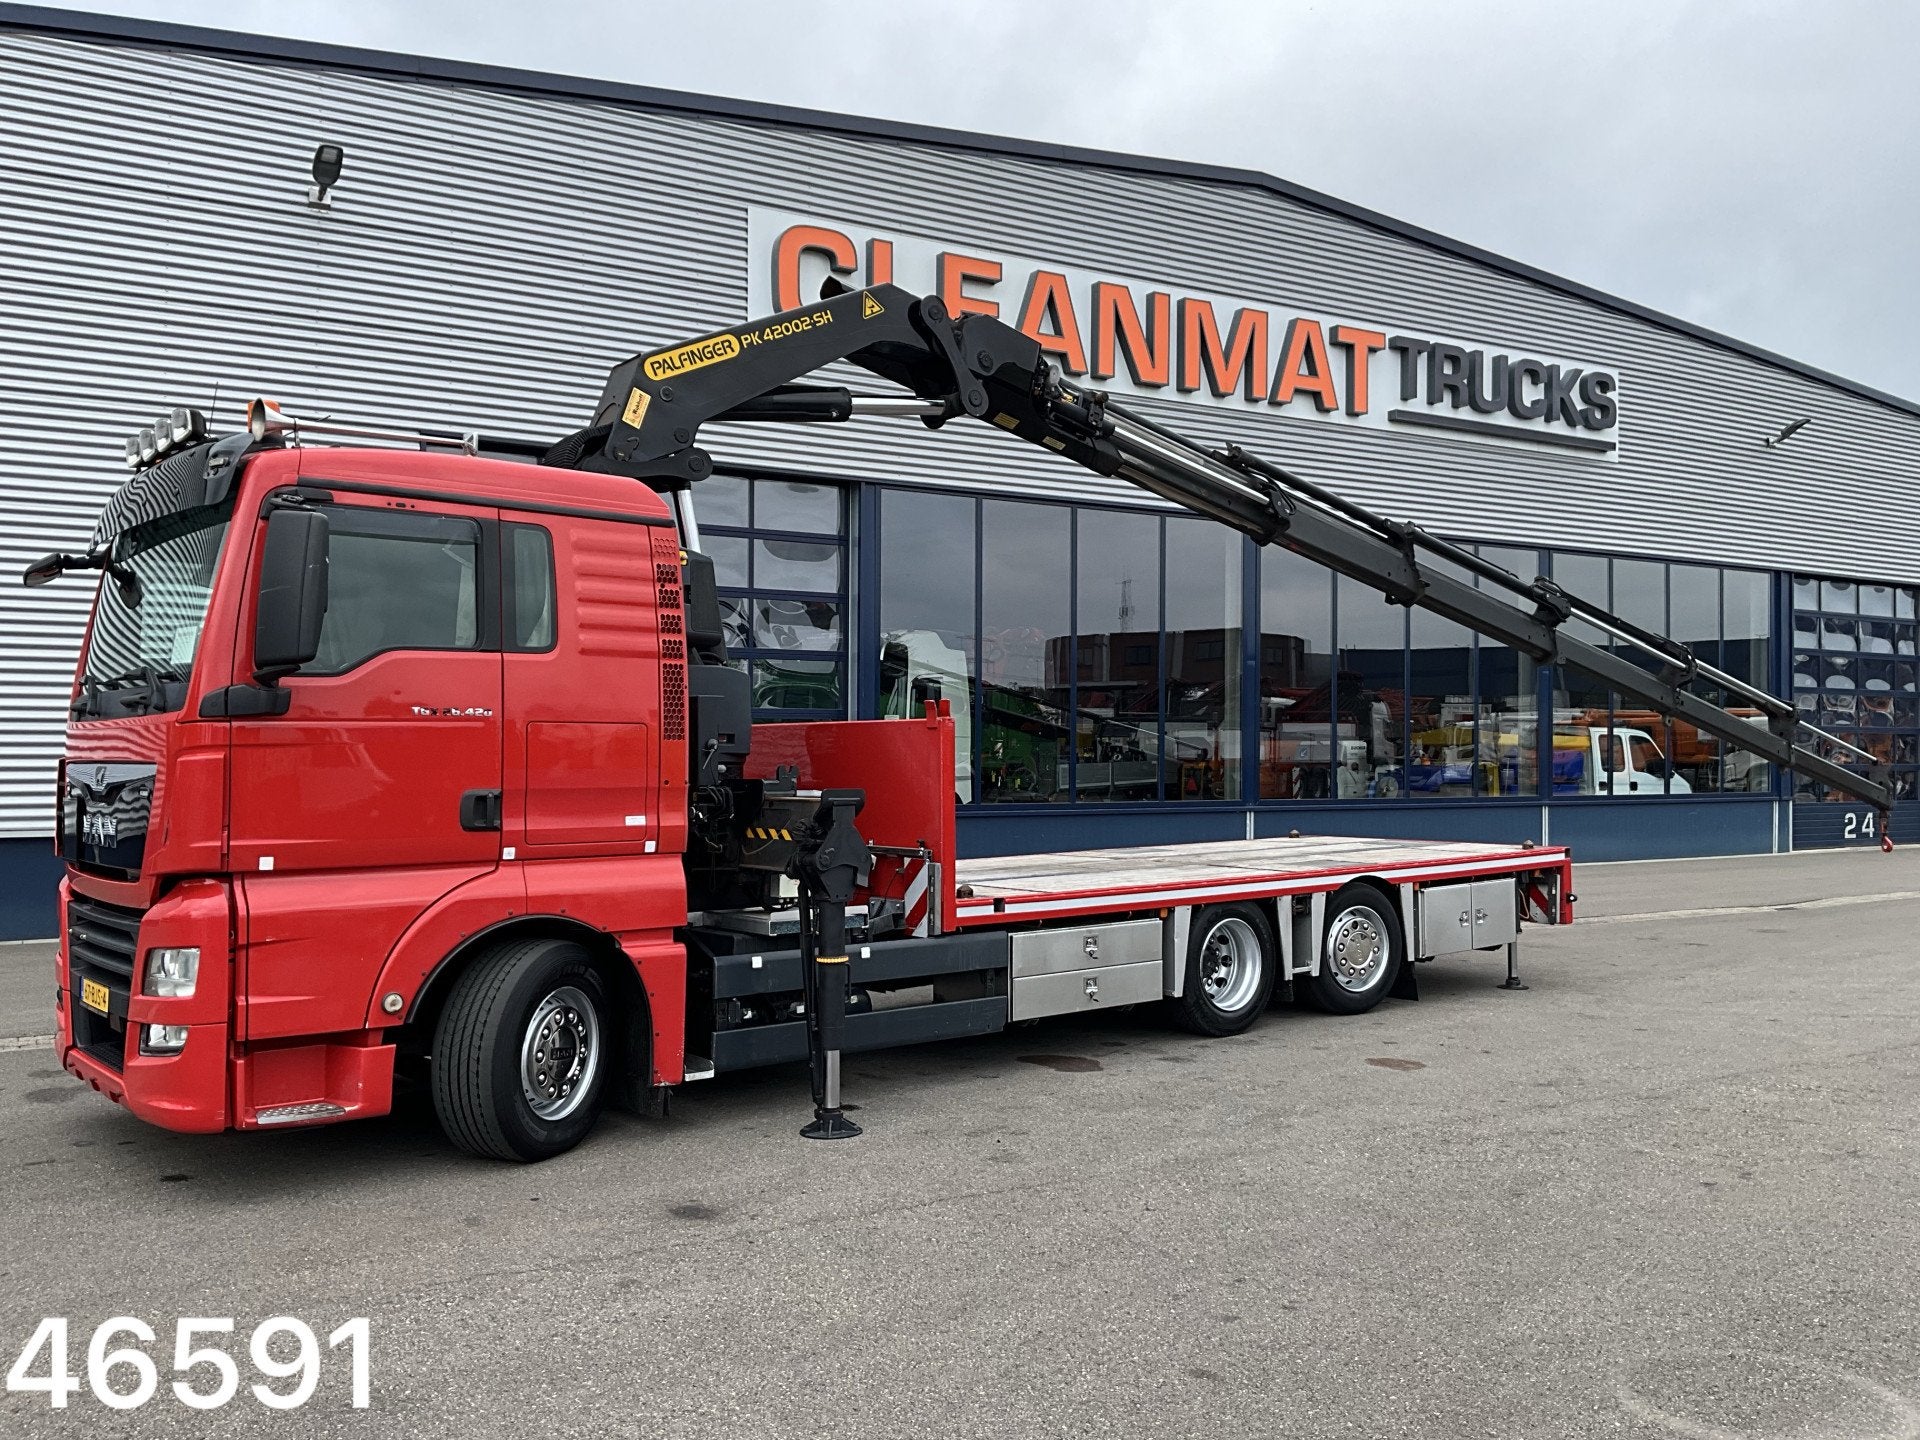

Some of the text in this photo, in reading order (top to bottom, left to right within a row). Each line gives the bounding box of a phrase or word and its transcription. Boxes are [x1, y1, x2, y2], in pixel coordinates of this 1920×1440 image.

[650, 338, 735, 377] PALFINGER
[740, 331, 763, 348] PK
[1388, 336, 1617, 431] TRUCKS
[1844, 812, 1875, 839] 24
